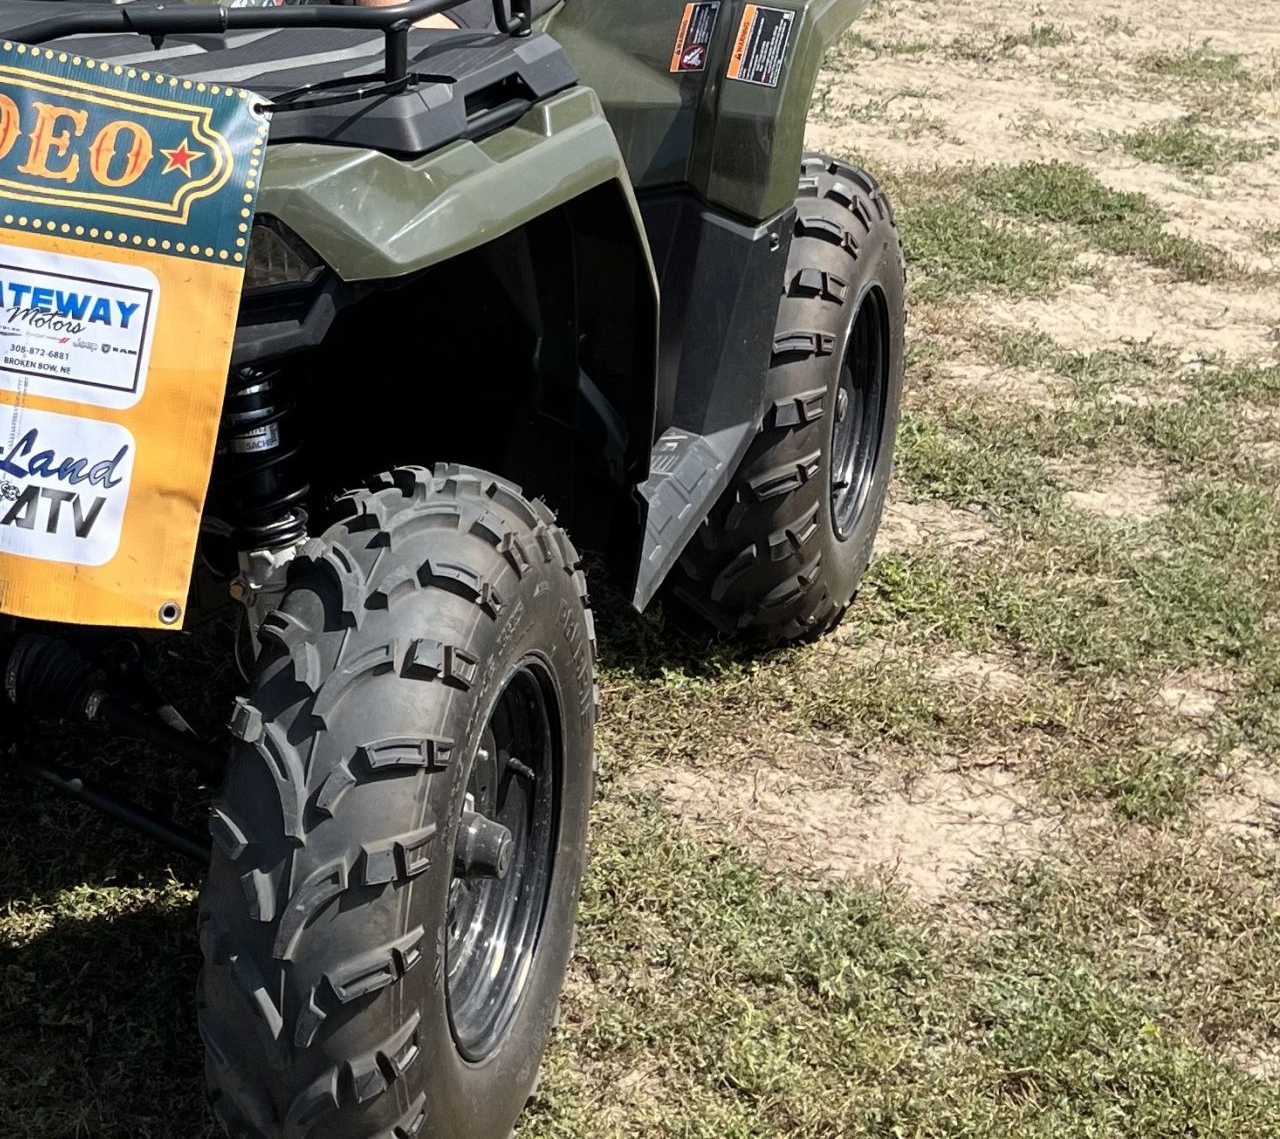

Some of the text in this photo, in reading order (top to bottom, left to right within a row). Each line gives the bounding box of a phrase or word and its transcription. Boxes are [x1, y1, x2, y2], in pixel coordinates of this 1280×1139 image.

[737, 21, 750, 54] WARNING
[6, 306, 86, 335] Motors
[9, 343, 70, 361] 308-872-6881
[3, 356, 72, 375] BROKEN BOW, NE
[246, 438, 274, 451] SACHS
[0, 484, 107, 539] ATV
